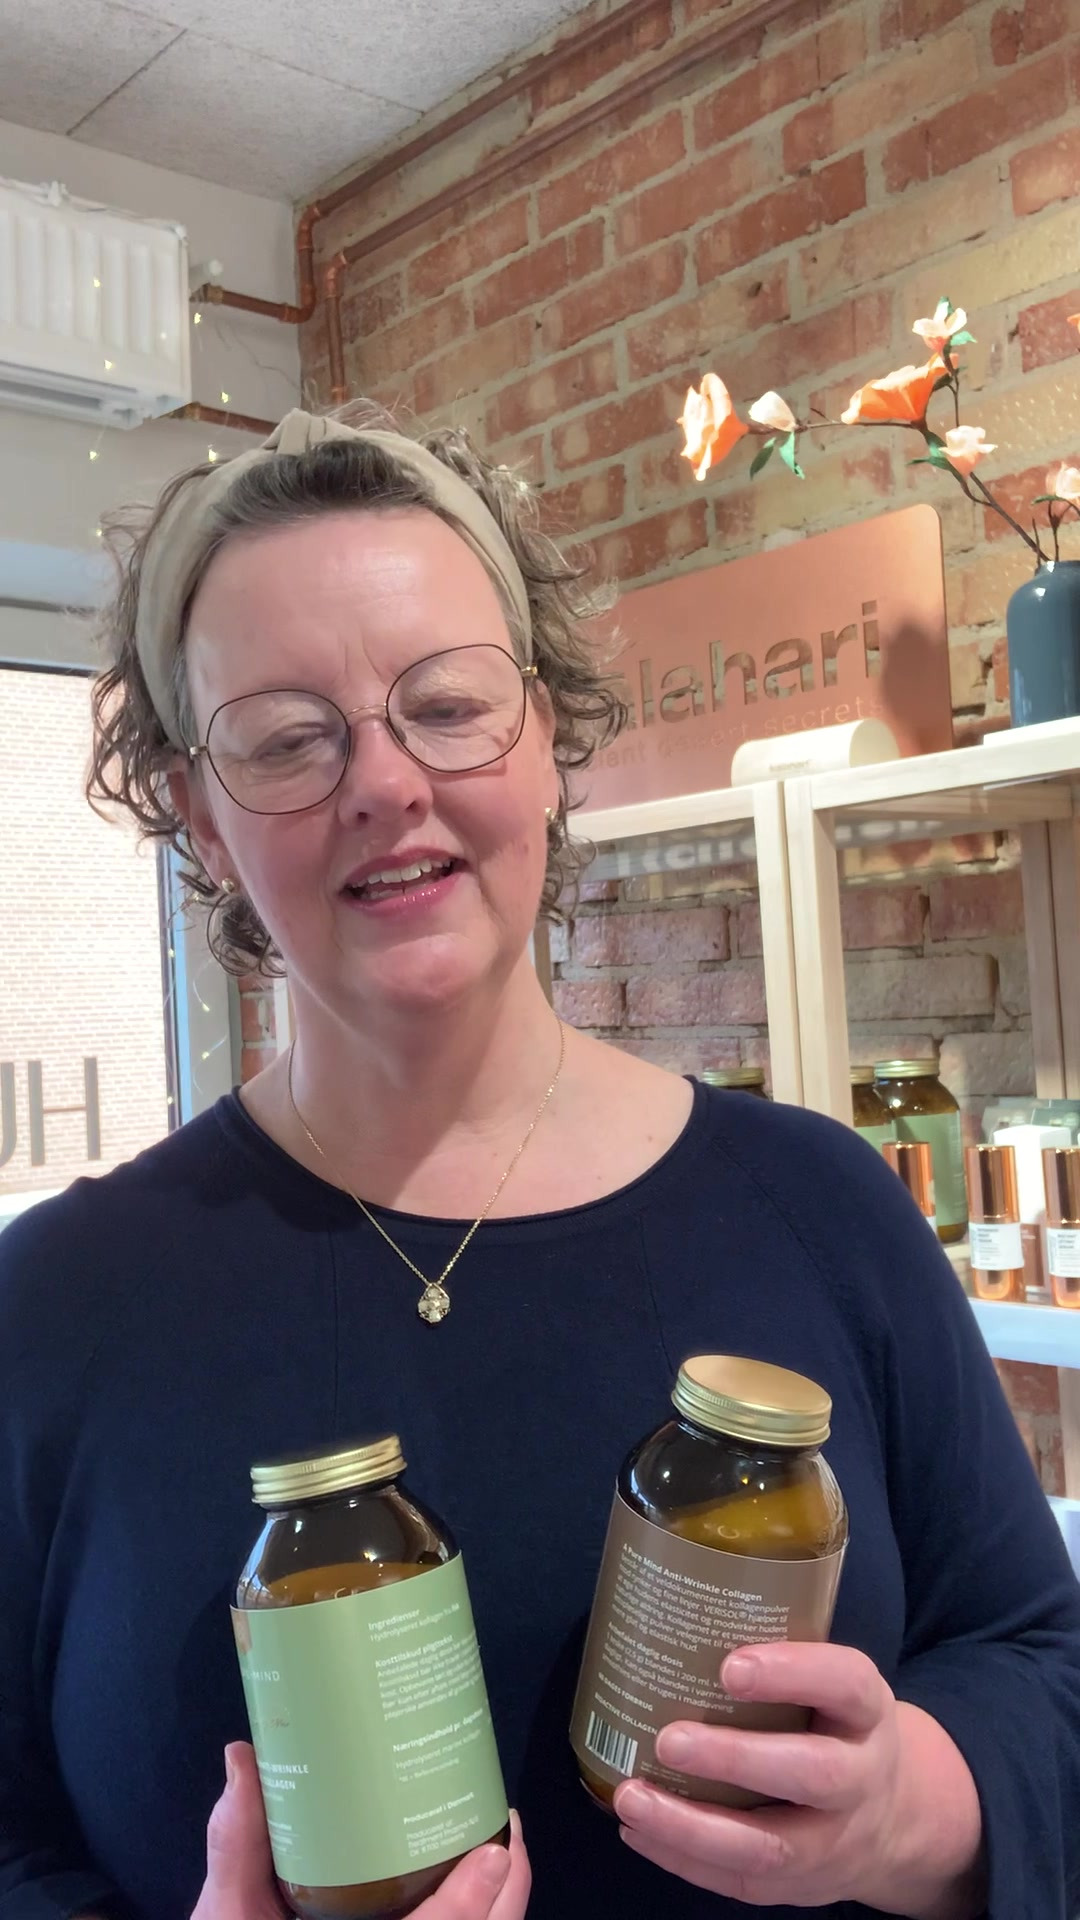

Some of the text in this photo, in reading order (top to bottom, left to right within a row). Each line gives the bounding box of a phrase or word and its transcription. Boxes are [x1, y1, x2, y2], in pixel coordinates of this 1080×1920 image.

[622, 600, 880, 731] lahari
[628, 1546, 643, 1562] Pure
[643, 1557, 662, 1574] Mind
[663, 1568, 720, 1594] Anti-Wrinkle
[722, 1588, 762, 1602] Collagen
[652, 1586, 662, 1597] og
[663, 1590, 679, 1601] fine
[679, 1596, 700, 1610] linjer.
[748, 1614, 779, 1624] hjælper
[779, 1615, 788, 1623] til
[656, 1576, 727, 1606] veldokumenteret
[728, 1600, 790, 1614] kollagenpulver
[368, 1608, 420, 1631] Ingredienser
[650, 1618, 674, 1633] pulver
[676, 1629, 711, 1645] velegnet
[714, 1640, 723, 1648] til
[667, 1614, 710, 1635] Kollagenet
[710, 1629, 720, 1637] er
[700, 1616, 712, 1626] og
[713, 1619, 757, 1632] modvirker
[759, 1625, 788, 1633] hudens
[639, 1623, 648, 1635] og
[649, 1628, 678, 1646] elastisk
[680, 1641, 699, 1653] hud.
[376, 1647, 422, 1668] Kosttilskud
[637, 1642, 660, 1660] daglig
[661, 1654, 683, 1668] dosis
[252, 1670, 280, 1681] MIND
[645, 1658, 675, 1677] blandes
[681, 1672, 697, 1682] 200
[698, 1678, 710, 1687] ml.
[657, 1675, 690, 1692] blandes
[695, 1688, 723, 1699] varme
[604, 1677, 622, 1694] DAGES
[622, 1690, 654, 1712] FORBRUG
[631, 1675, 648, 1686] eller
[649, 1682, 677, 1700] bruges
[682, 1696, 736, 1714] madlavning.
[595, 1691, 658, 1736] BIOACTIVE COLLAGEN
[392, 1724, 453, 1752] Næringsindhold
[396, 1749, 441, 1769] Hydrolyseret
[404, 1806, 442, 1824] Produceret
[447, 1792, 474, 1809] Danmark
